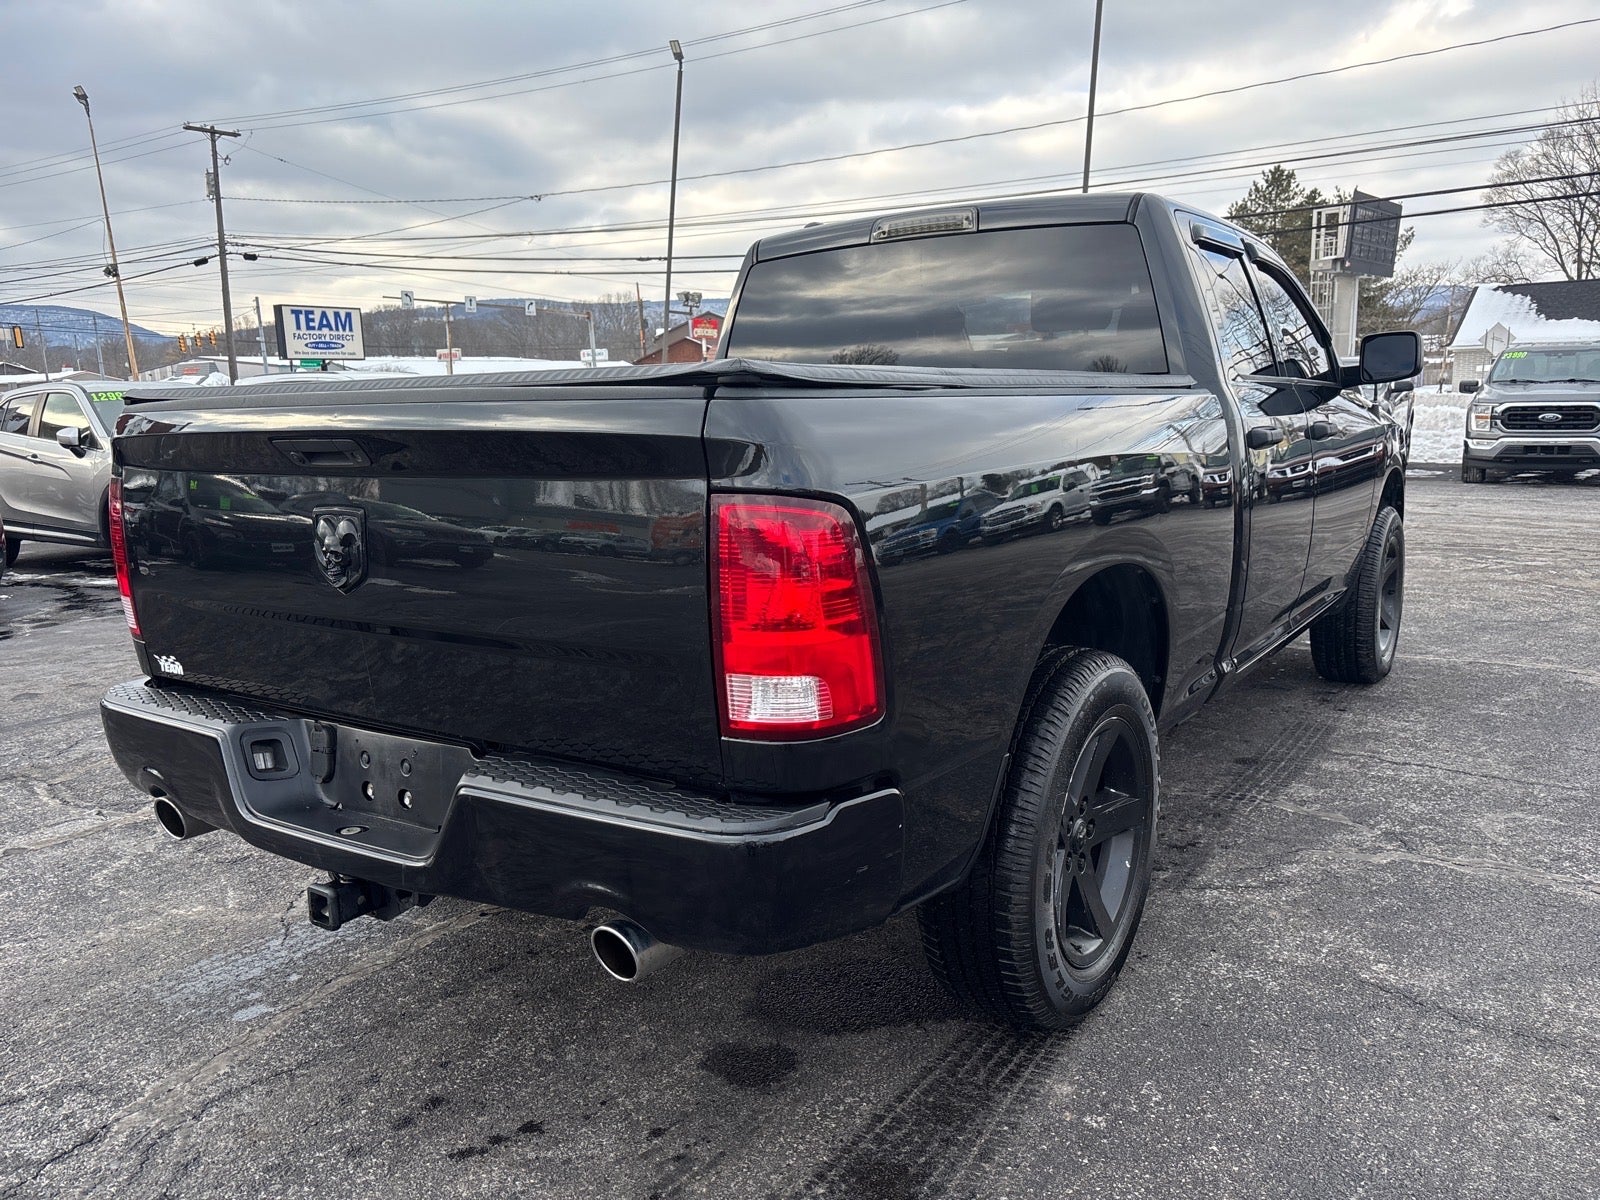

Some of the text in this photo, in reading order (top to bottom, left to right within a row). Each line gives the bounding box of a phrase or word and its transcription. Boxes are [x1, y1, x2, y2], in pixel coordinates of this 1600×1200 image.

[290, 309, 353, 332] TEAM
[293, 332, 355, 342] FACTORY DIRECT
[159, 660, 184, 675] TEAM
